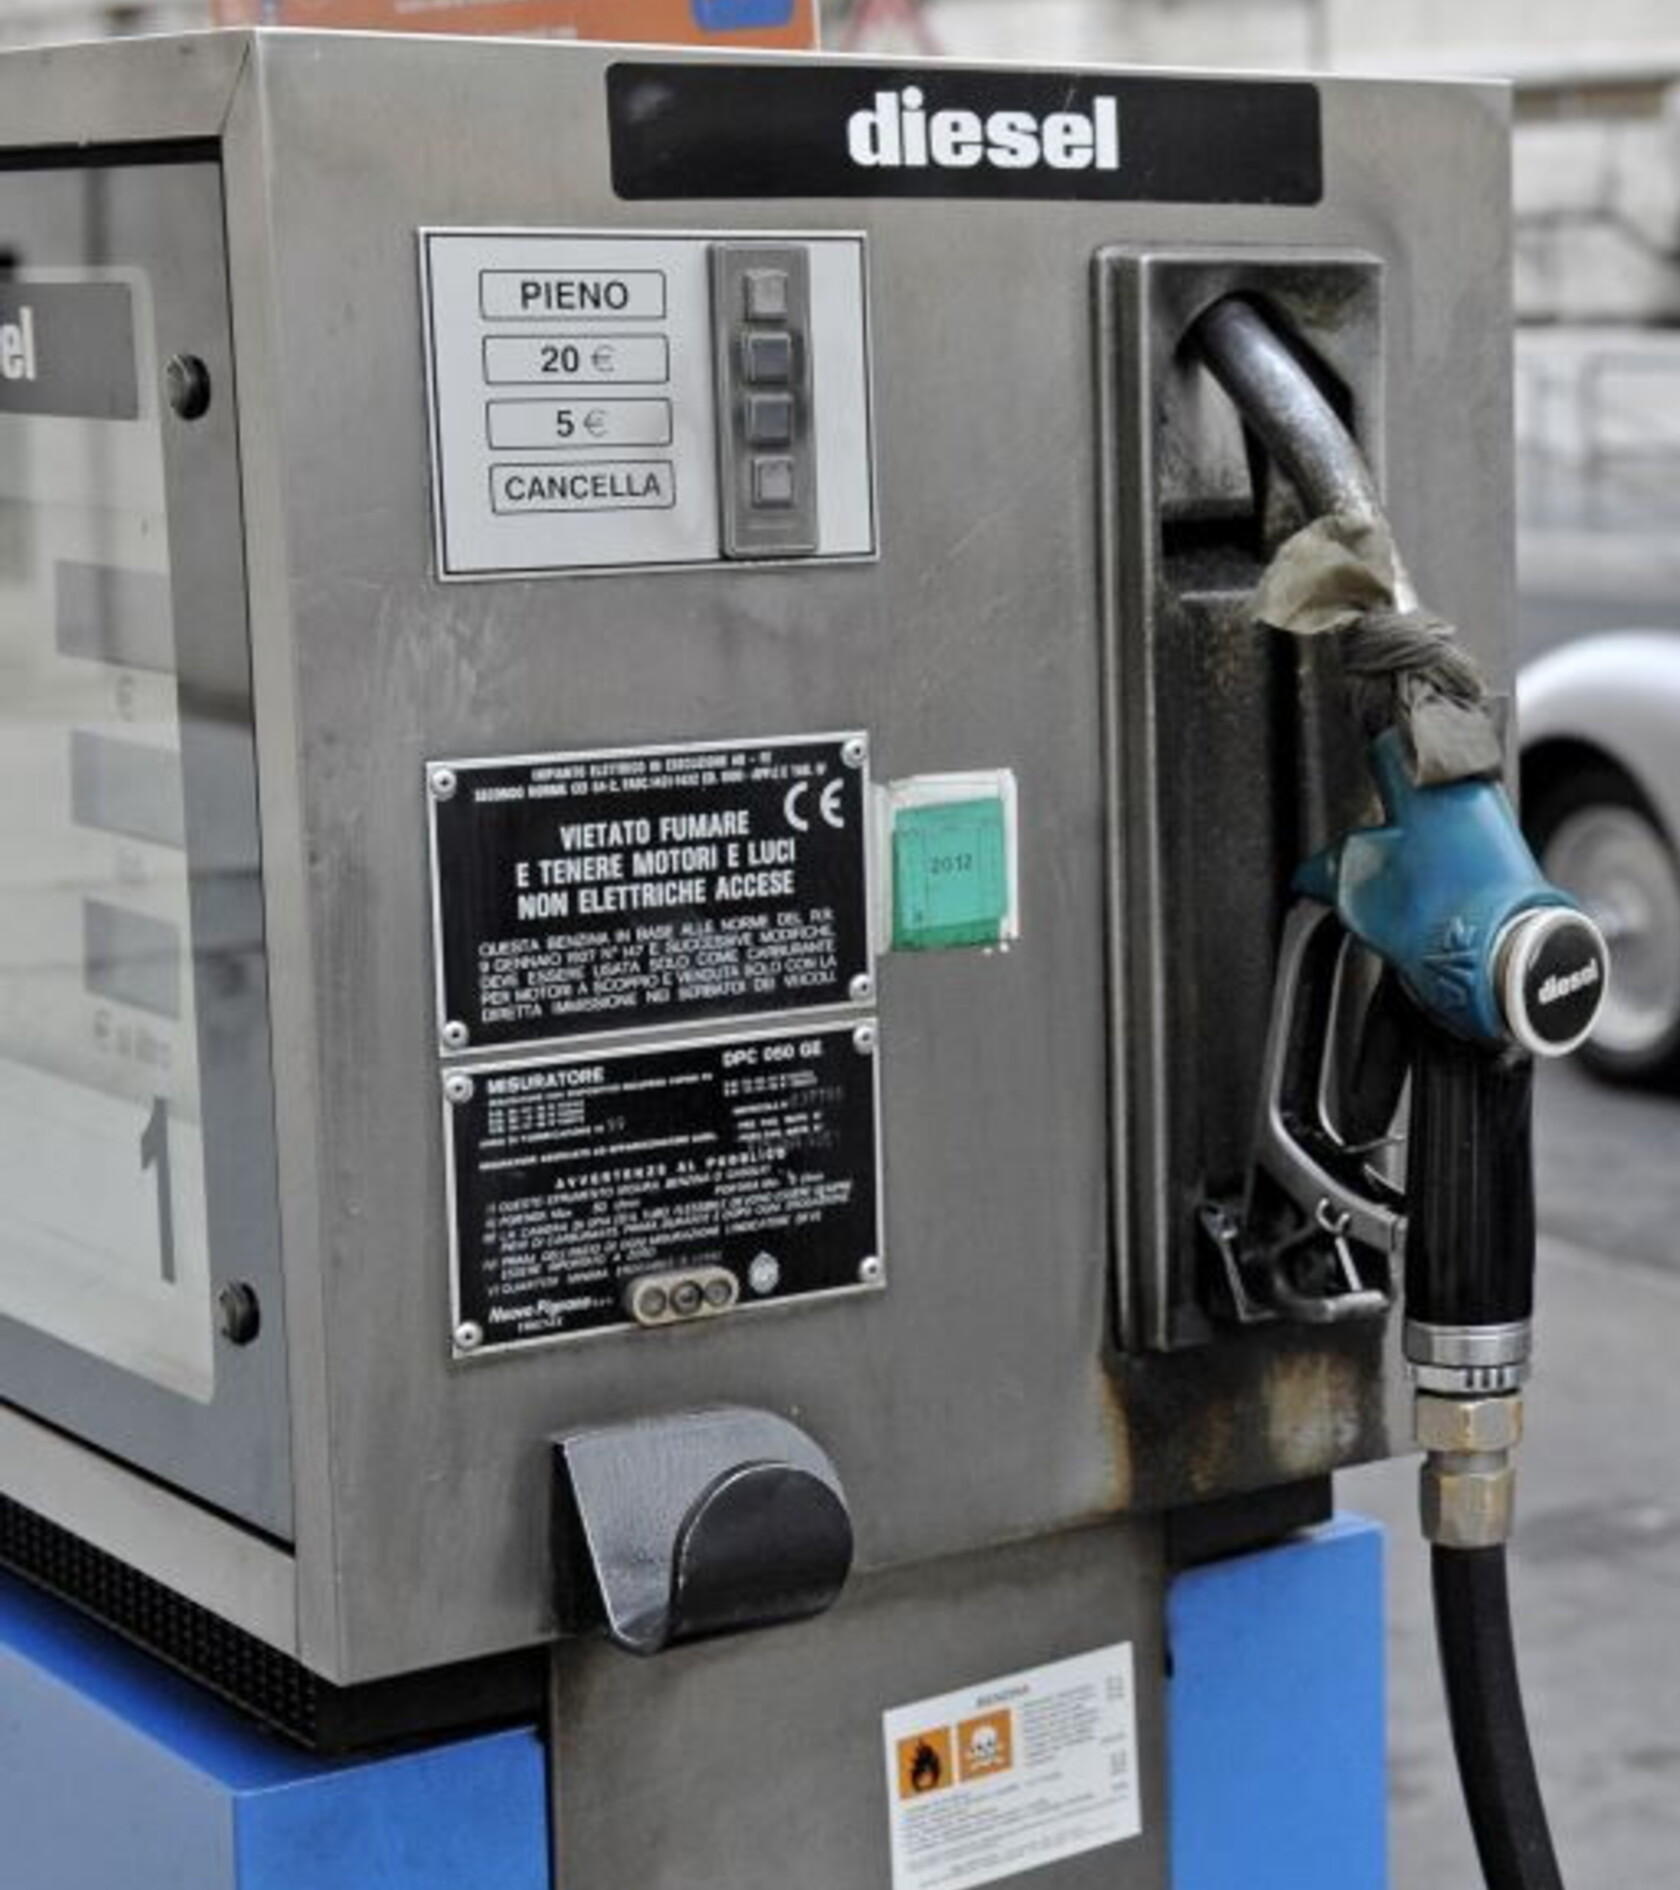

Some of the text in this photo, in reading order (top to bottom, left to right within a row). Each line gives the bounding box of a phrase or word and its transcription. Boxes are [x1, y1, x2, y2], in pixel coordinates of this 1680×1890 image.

[847, 86, 1120, 171] diesel
[520, 280, 629, 310] PIENO
[541, 345, 616, 373] 20 €
[556, 410, 608, 438] 5 €
[504, 473, 661, 501] CANCELLA
[784, 778, 845, 831] CE
[560, 810, 749, 851] VIETATO FUMARE
[516, 836, 796, 887] E TENERE MOTORI E LUCI
[930, 853, 972, 875] 2012
[517, 868, 796, 921] NON ELETTRICHE ACCESE
[1538, 958, 1599, 1005] diesel
[487, 1066, 605, 1094] MISURATORE
[721, 1046, 759, 1068] DPC
[140, 1096, 175, 1285] 1
